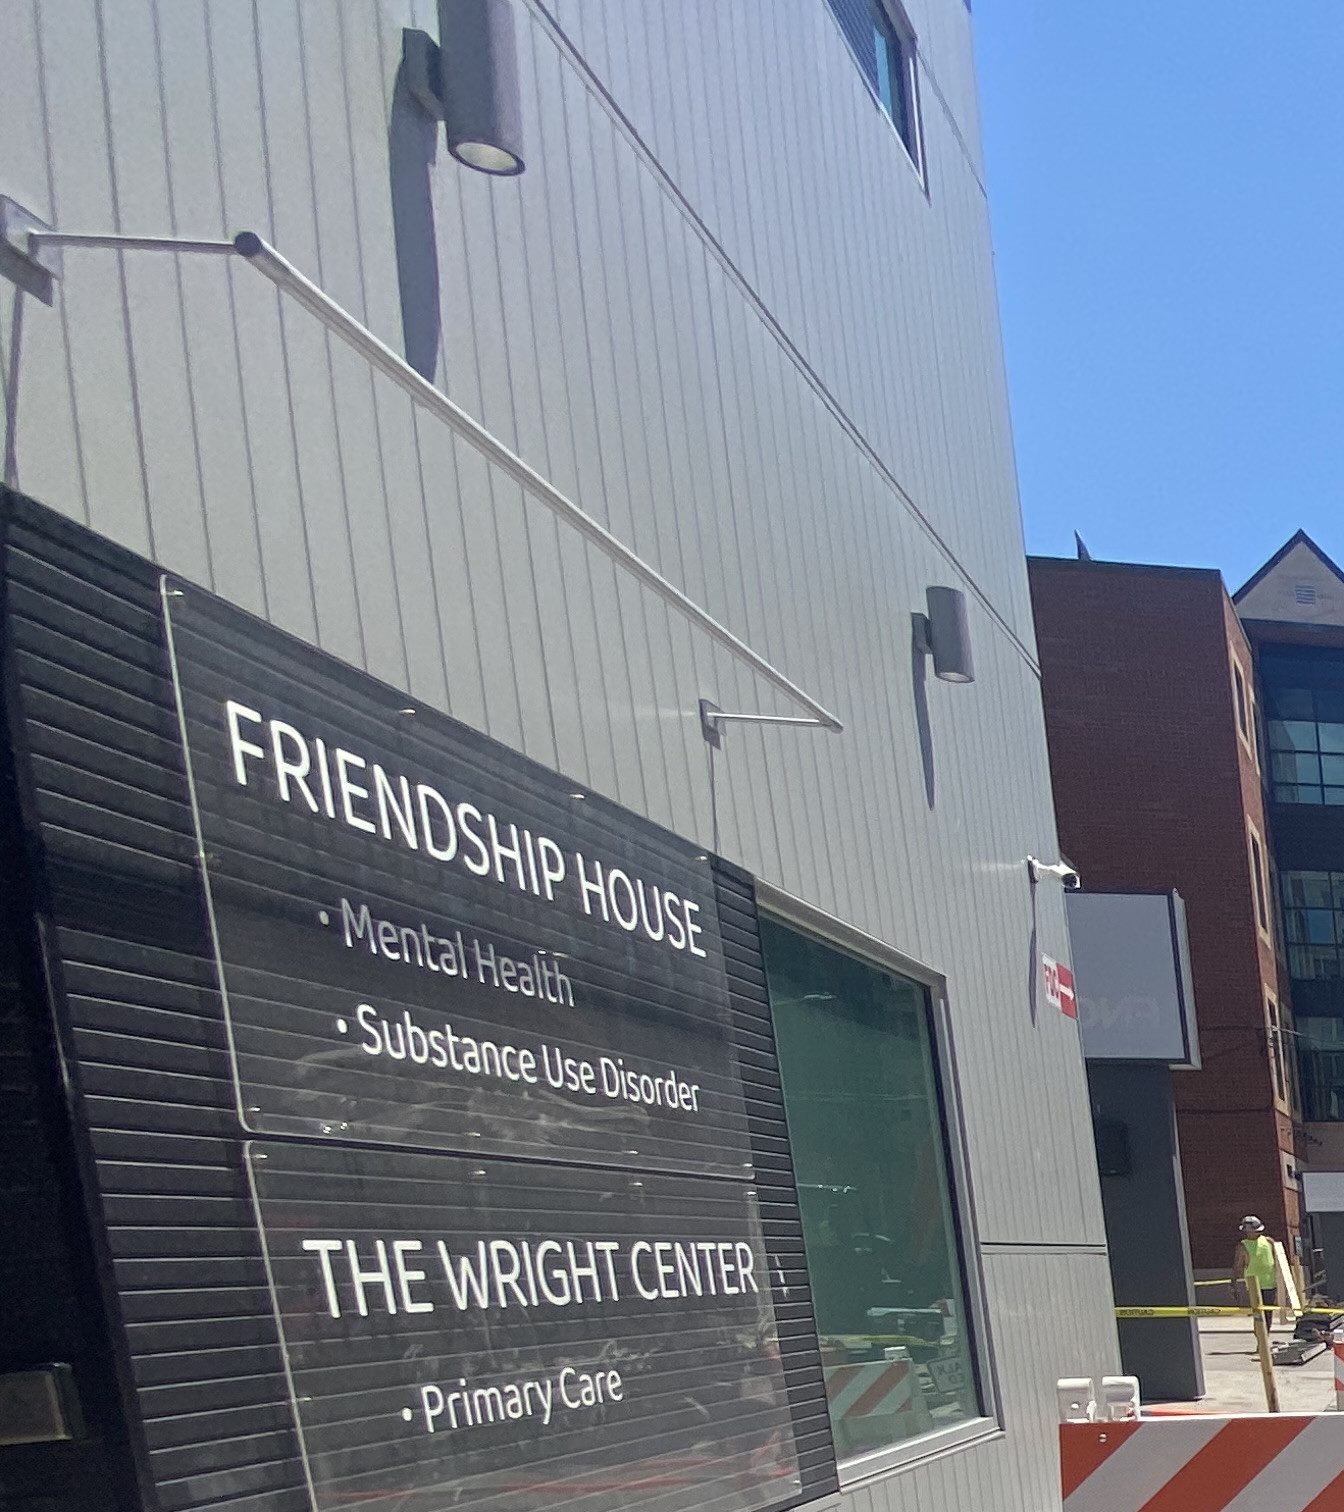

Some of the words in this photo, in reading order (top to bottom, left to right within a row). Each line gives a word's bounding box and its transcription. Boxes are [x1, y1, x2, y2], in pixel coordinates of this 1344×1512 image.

[227, 700, 565, 899] FRIENDSHIP
[578, 852, 708, 958] HOUSE
[341, 898, 468, 980] Mental
[475, 938, 575, 1008] Health
[358, 1003, 536, 1083] Substance
[542, 1045, 596, 1096] Use
[602, 1057, 700, 1113] Disorder
[303, 1239, 434, 1318] THE
[438, 1239, 621, 1311] WRIGHT
[631, 1241, 759, 1300] CENTER
[421, 1375, 552, 1433] Primary
[560, 1366, 623, 1410] Care
